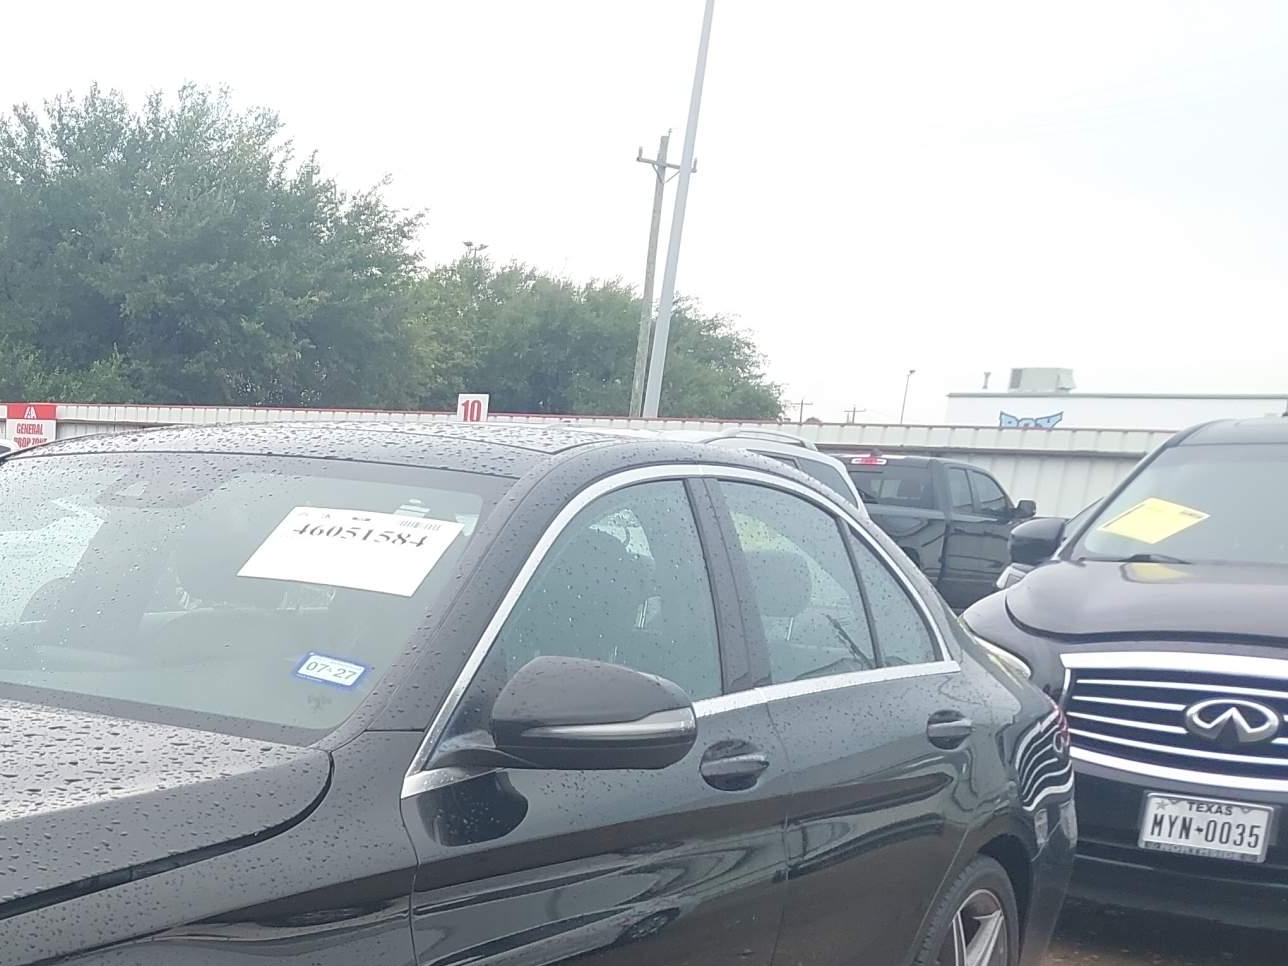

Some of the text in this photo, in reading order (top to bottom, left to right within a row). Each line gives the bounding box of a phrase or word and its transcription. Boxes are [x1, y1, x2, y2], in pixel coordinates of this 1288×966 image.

[461, 399, 482, 422] 10
[16, 423, 44, 435] GENERAL
[292, 522, 429, 548] 46051584
[1187, 801, 1234, 816] TEXAS
